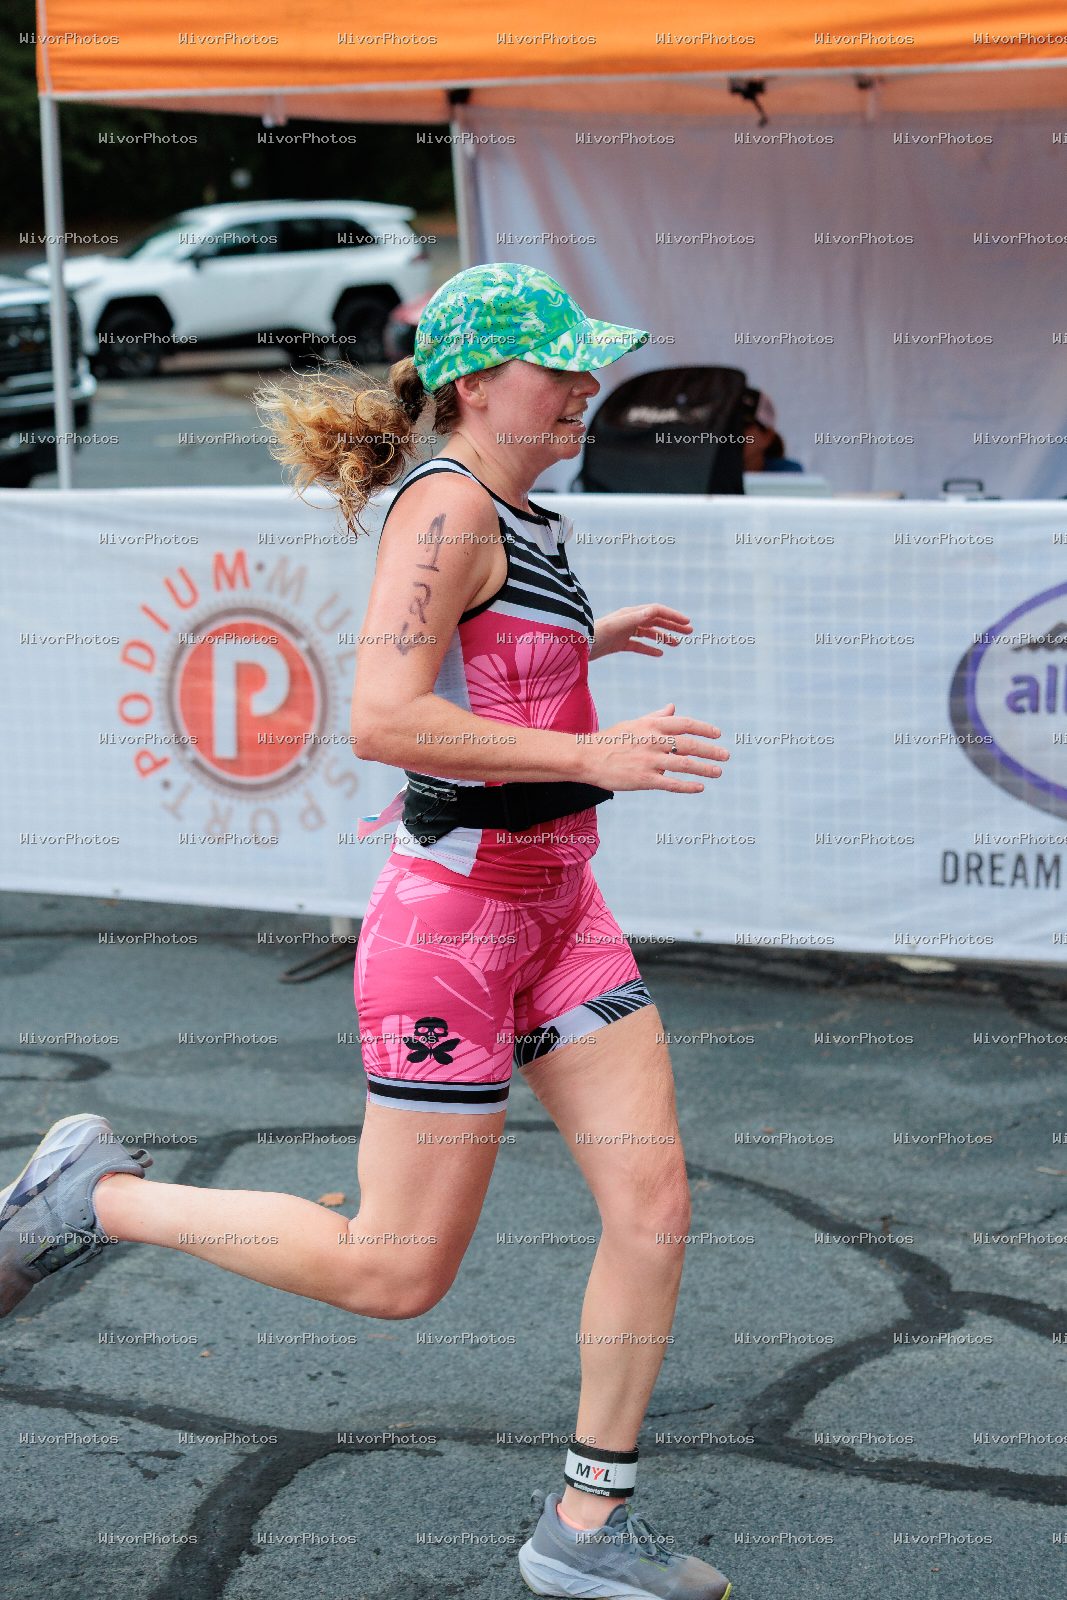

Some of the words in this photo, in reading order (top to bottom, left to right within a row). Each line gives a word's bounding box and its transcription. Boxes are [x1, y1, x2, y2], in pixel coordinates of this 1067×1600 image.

[117, 549, 251, 779] PODIUM
[1005, 663, 1067, 716] al
[162, 555, 360, 849] MULSPORT
[941, 850, 1062, 890] DREAM
[575, 1462, 612, 1483] MYL
